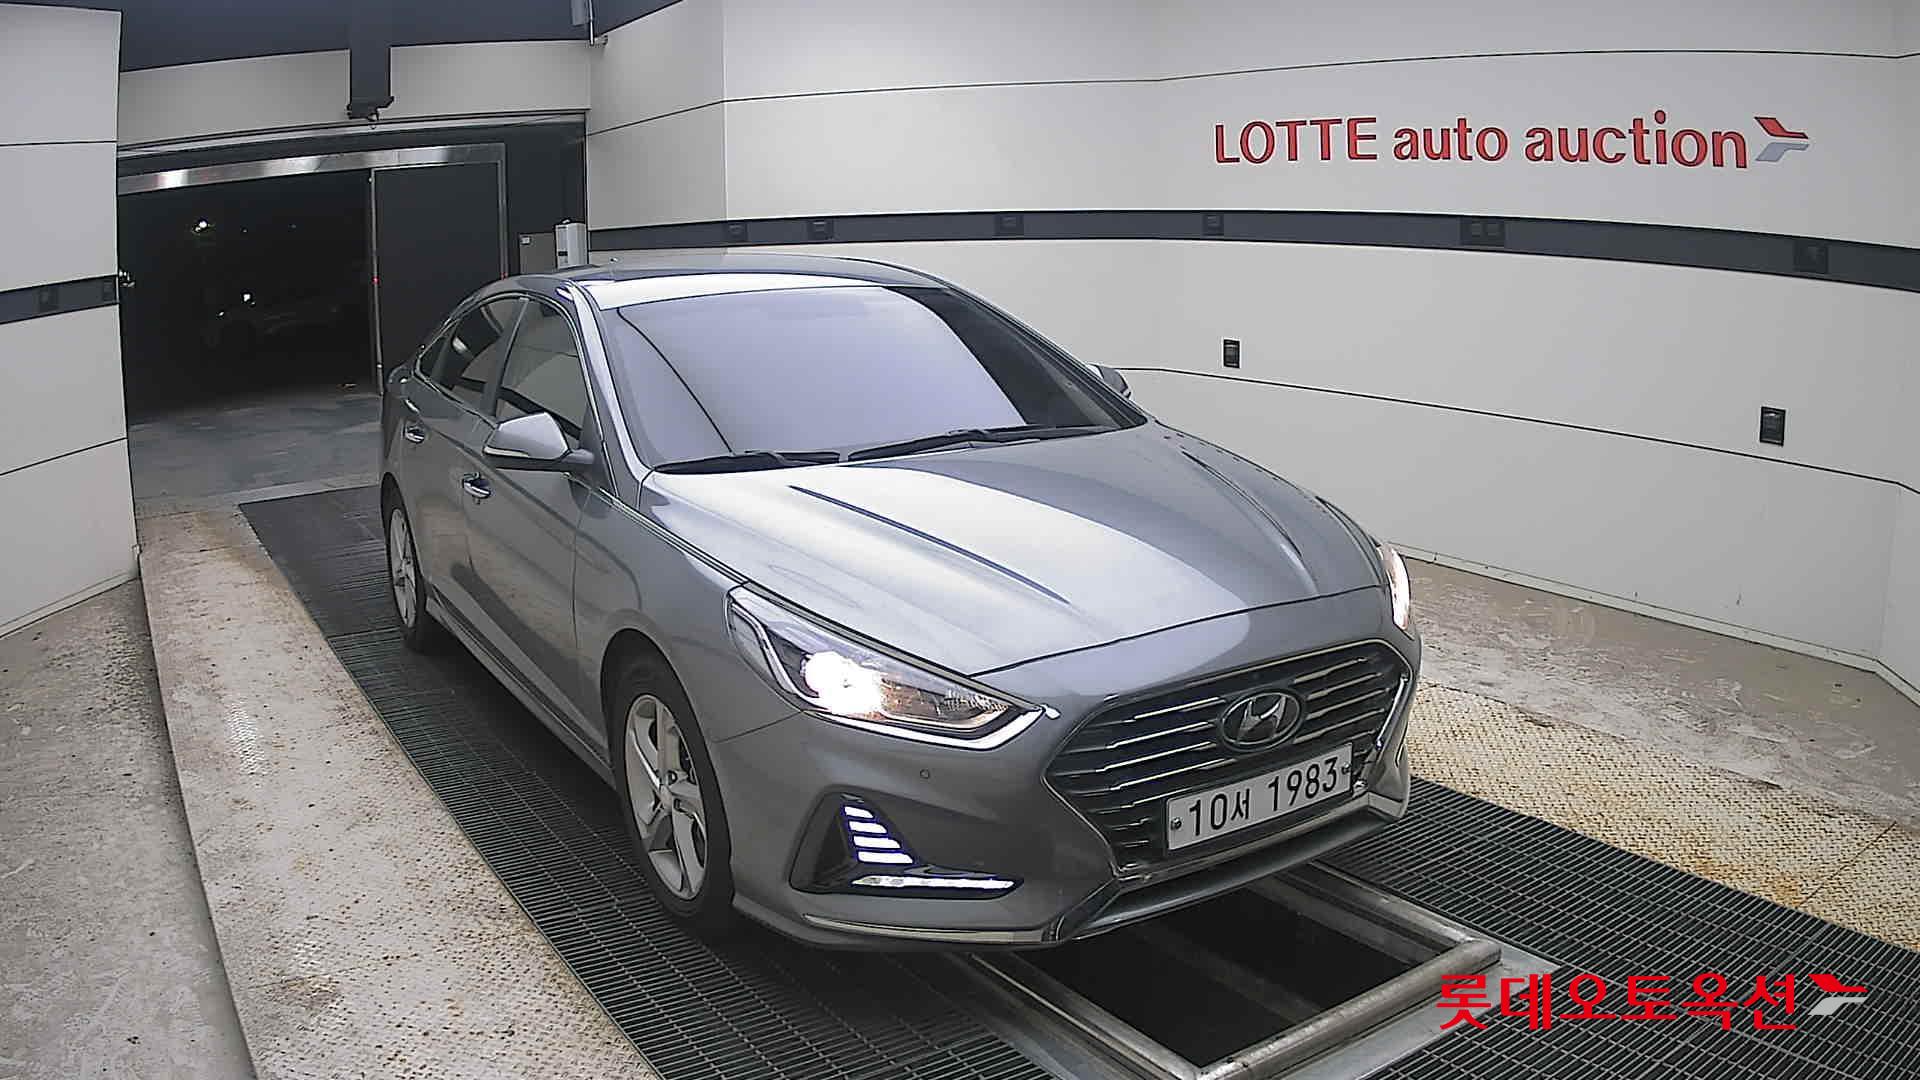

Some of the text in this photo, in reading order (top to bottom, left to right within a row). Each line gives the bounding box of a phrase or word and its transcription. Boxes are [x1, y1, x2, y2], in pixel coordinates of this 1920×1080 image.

[1214, 109, 1748, 169] LOTTE auto auction
[1188, 756, 1338, 836] 10서 1983
